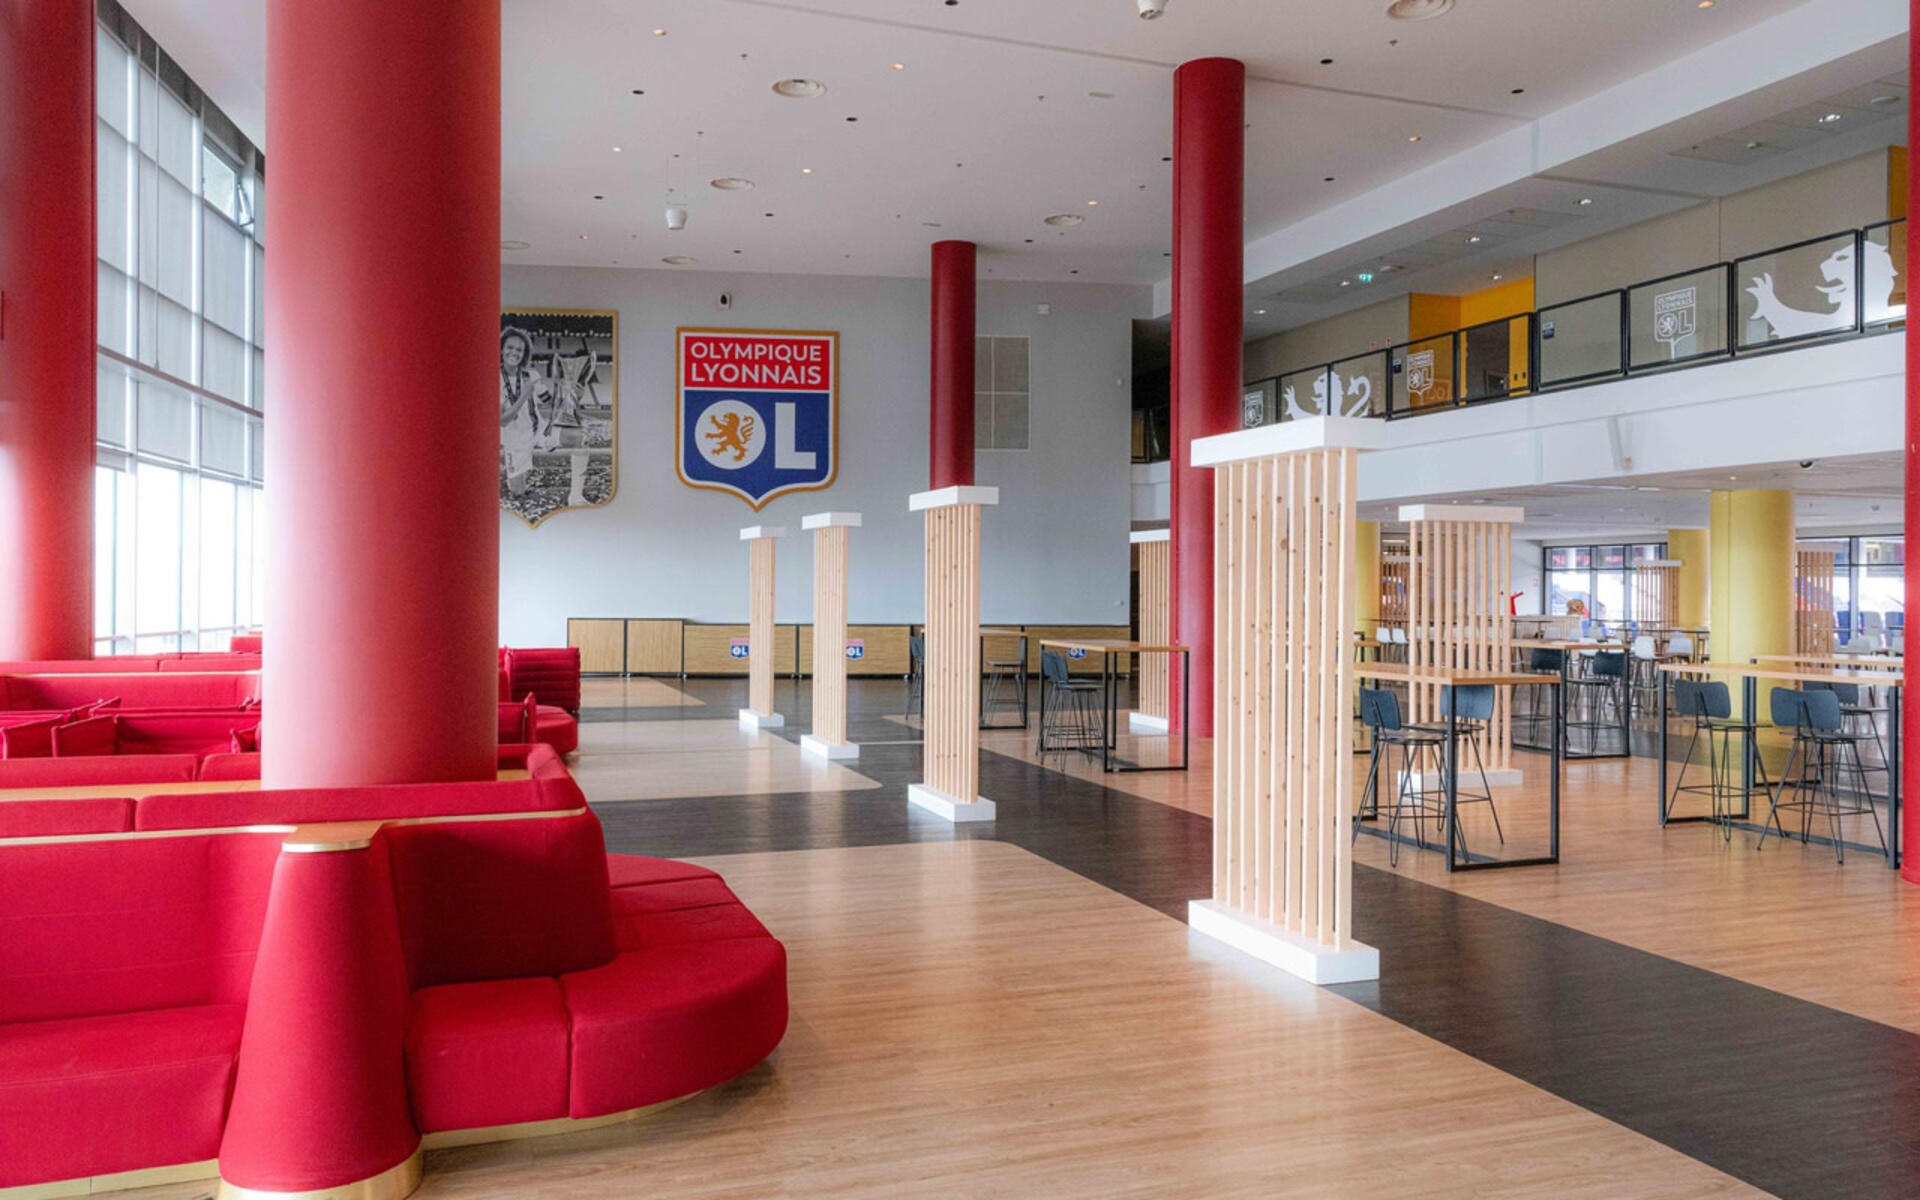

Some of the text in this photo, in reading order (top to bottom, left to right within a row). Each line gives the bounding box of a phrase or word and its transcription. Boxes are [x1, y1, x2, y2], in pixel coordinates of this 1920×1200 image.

[690, 341, 822, 364] OLYMPIQUE
[690, 363, 822, 385] LYONNAIS
[694, 399, 817, 470] OL
[732, 645, 748, 656] OL
[846, 646, 862, 656] OL
